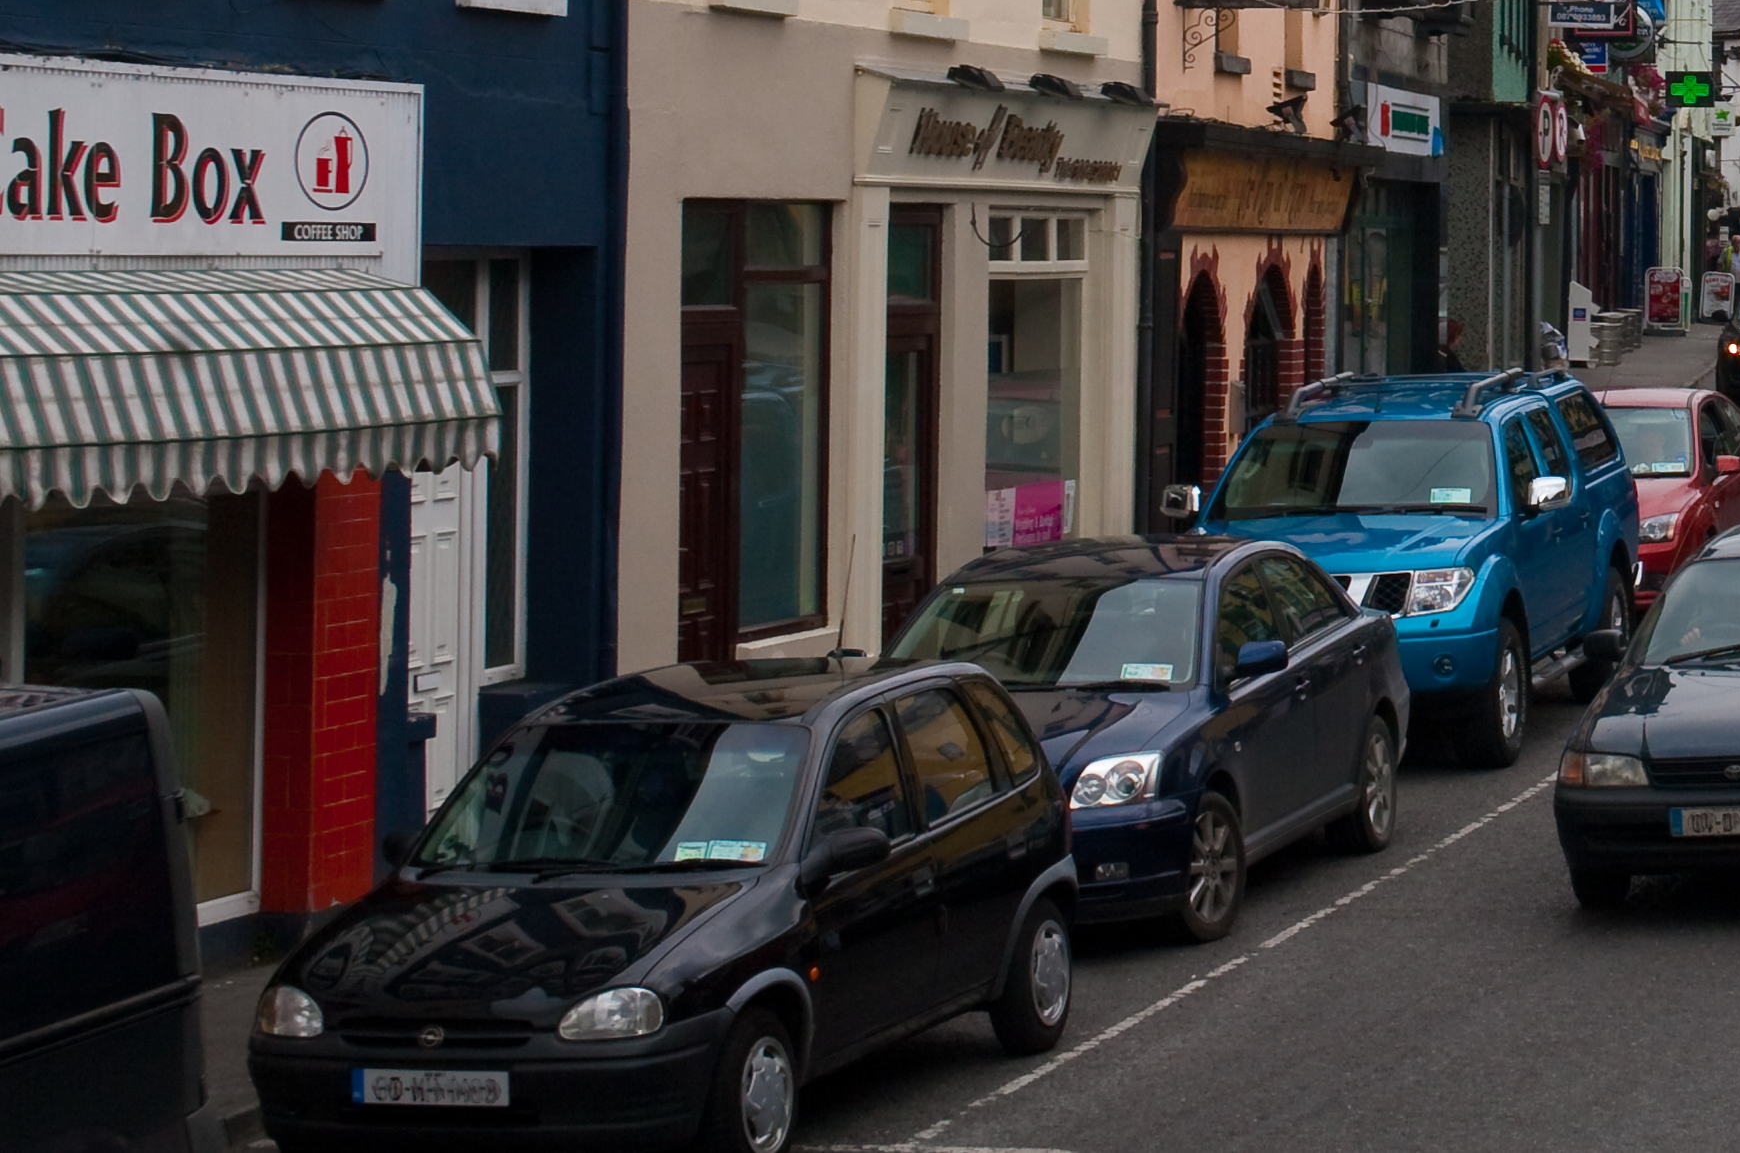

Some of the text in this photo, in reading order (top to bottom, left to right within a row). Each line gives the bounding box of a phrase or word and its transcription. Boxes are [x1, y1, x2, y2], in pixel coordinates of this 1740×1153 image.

[0, 105, 267, 226] ake Box
[293, 224, 364, 241] COFFEE SHOP
